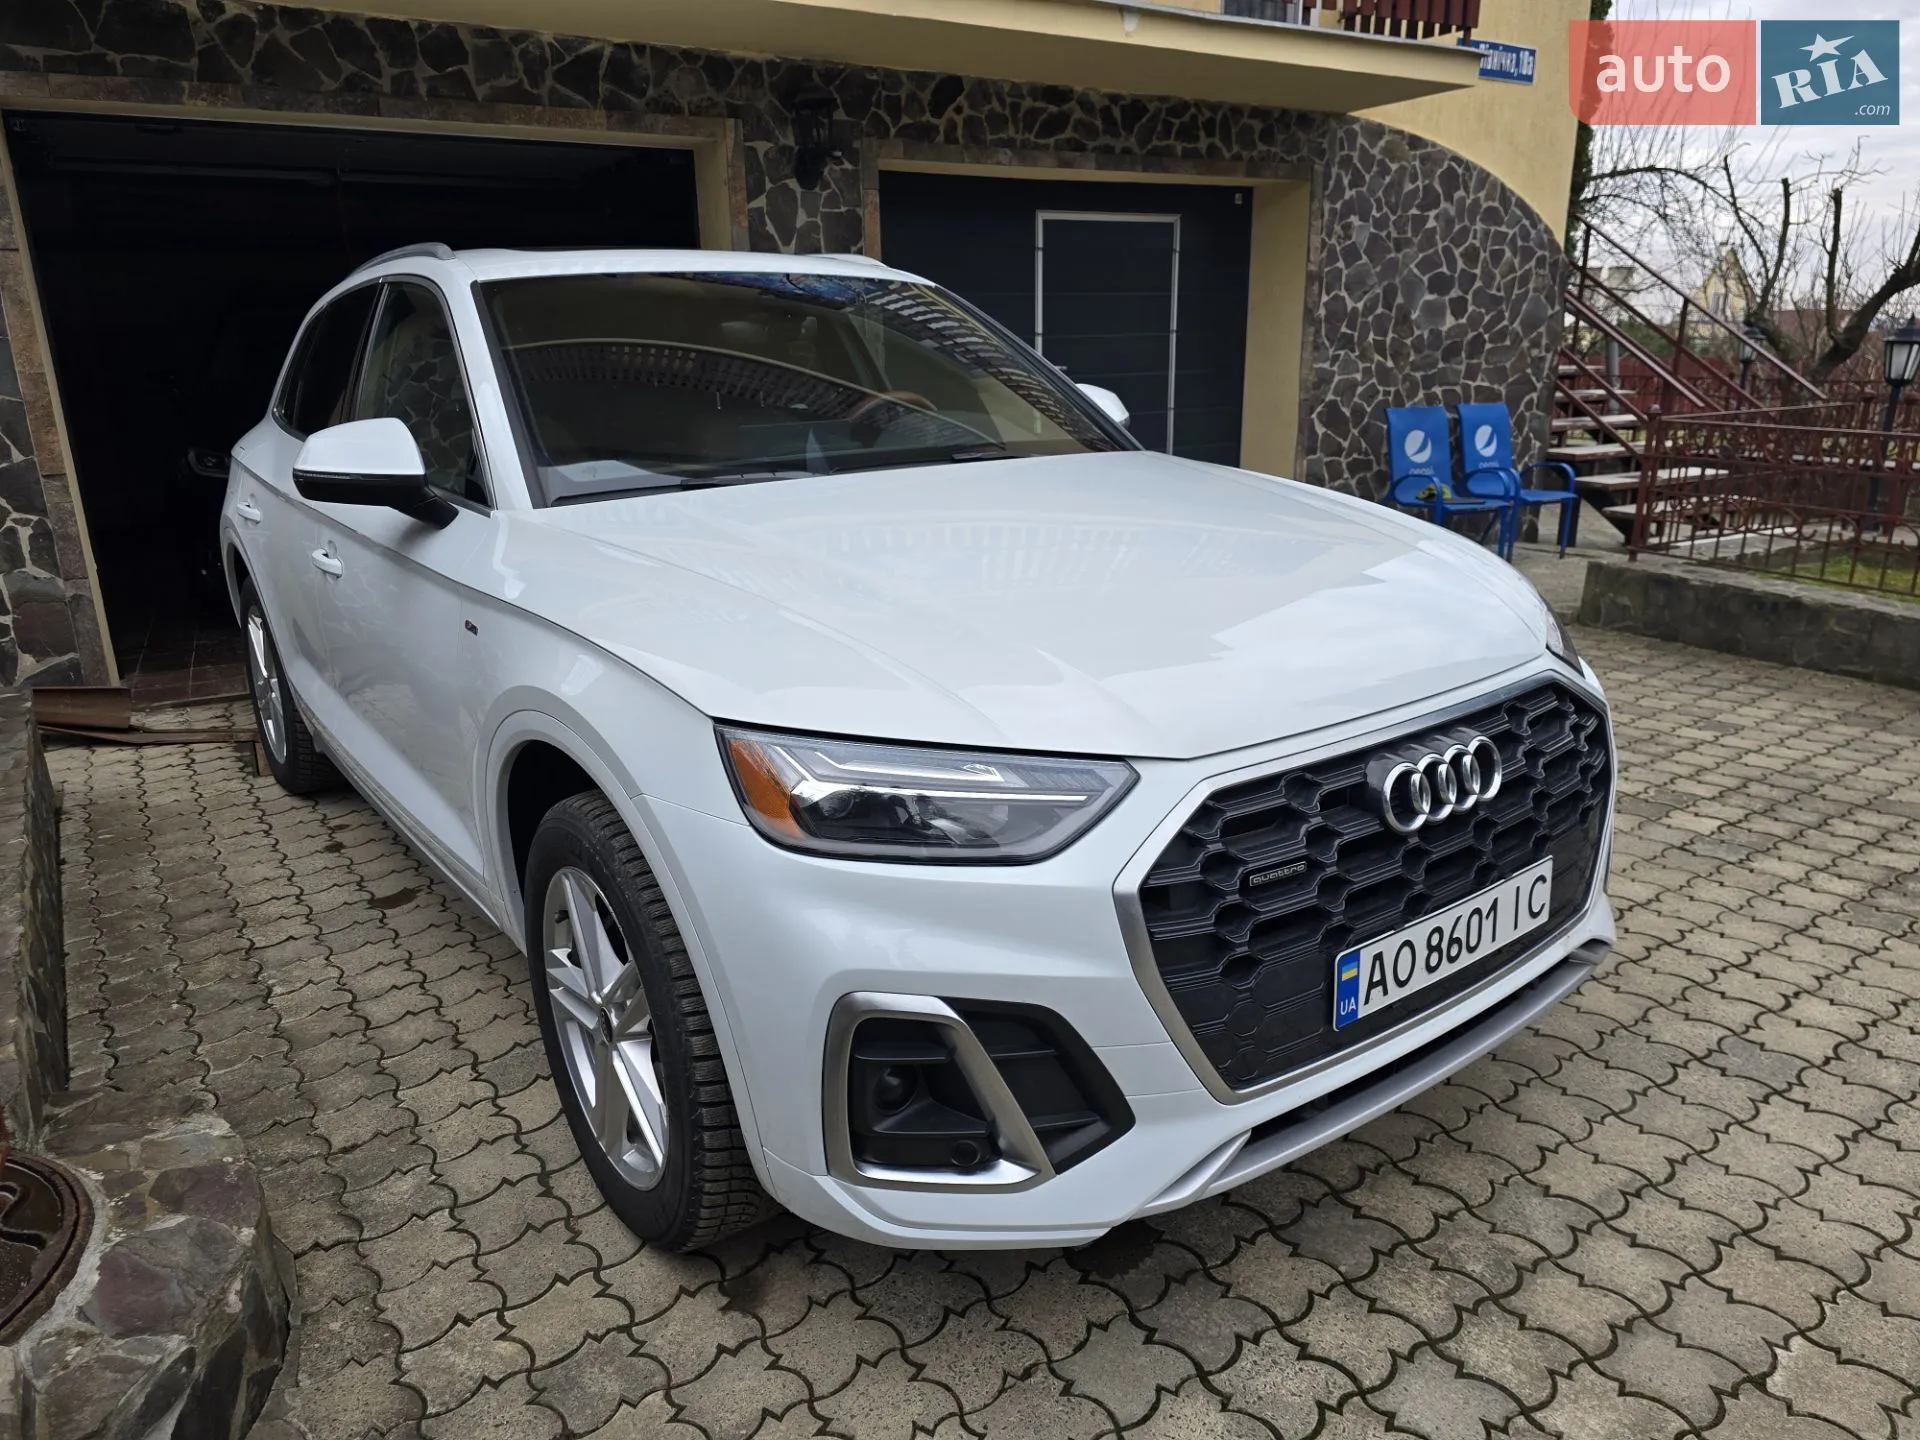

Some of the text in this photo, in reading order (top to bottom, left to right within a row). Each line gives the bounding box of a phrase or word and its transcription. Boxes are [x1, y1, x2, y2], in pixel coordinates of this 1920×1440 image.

[1253, 864, 1305, 884] quattro
[1425, 897, 1499, 975] 8601
[1340, 996, 1357, 1015] UA
